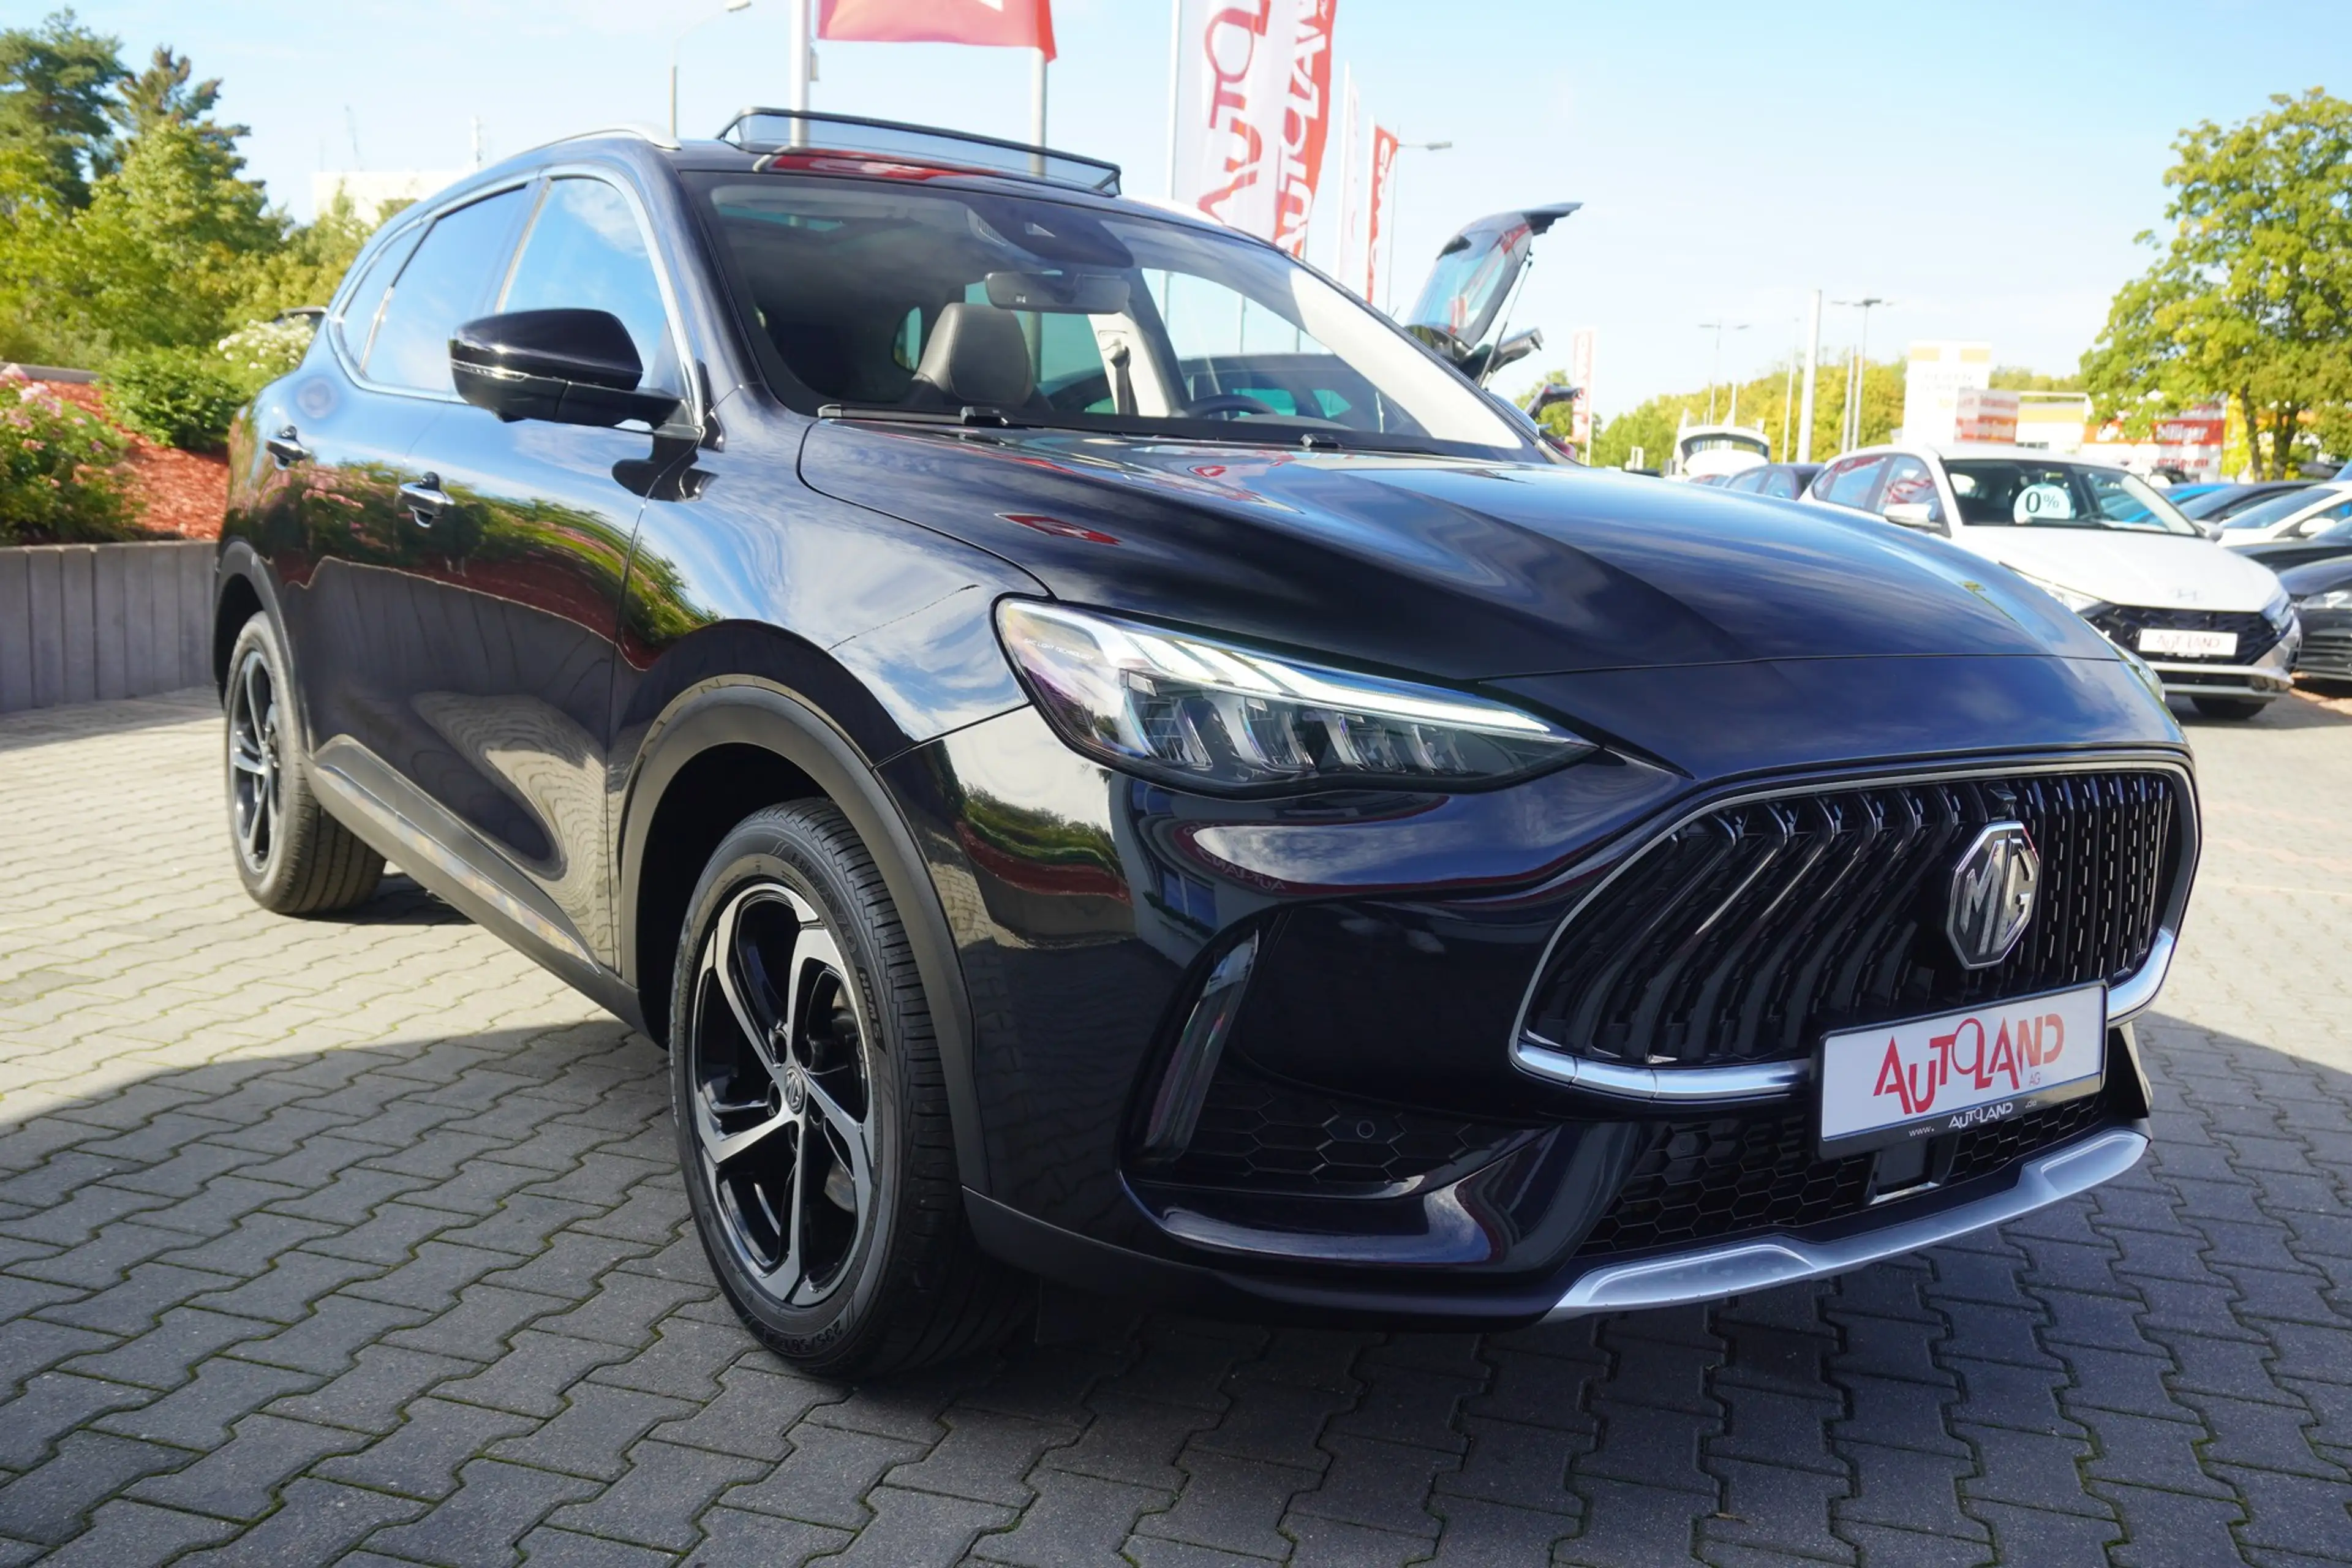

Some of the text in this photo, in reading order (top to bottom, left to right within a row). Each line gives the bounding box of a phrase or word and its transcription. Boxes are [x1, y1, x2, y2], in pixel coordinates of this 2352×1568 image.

[1960, 837, 2034, 956] MG
[1873, 1014, 2064, 1115] AUTOLAND
[2029, 1072, 2041, 1087] AG
[1909, 1126, 1935, 1137] www.
[1948, 1102, 2013, 1129] AUTOLAND
